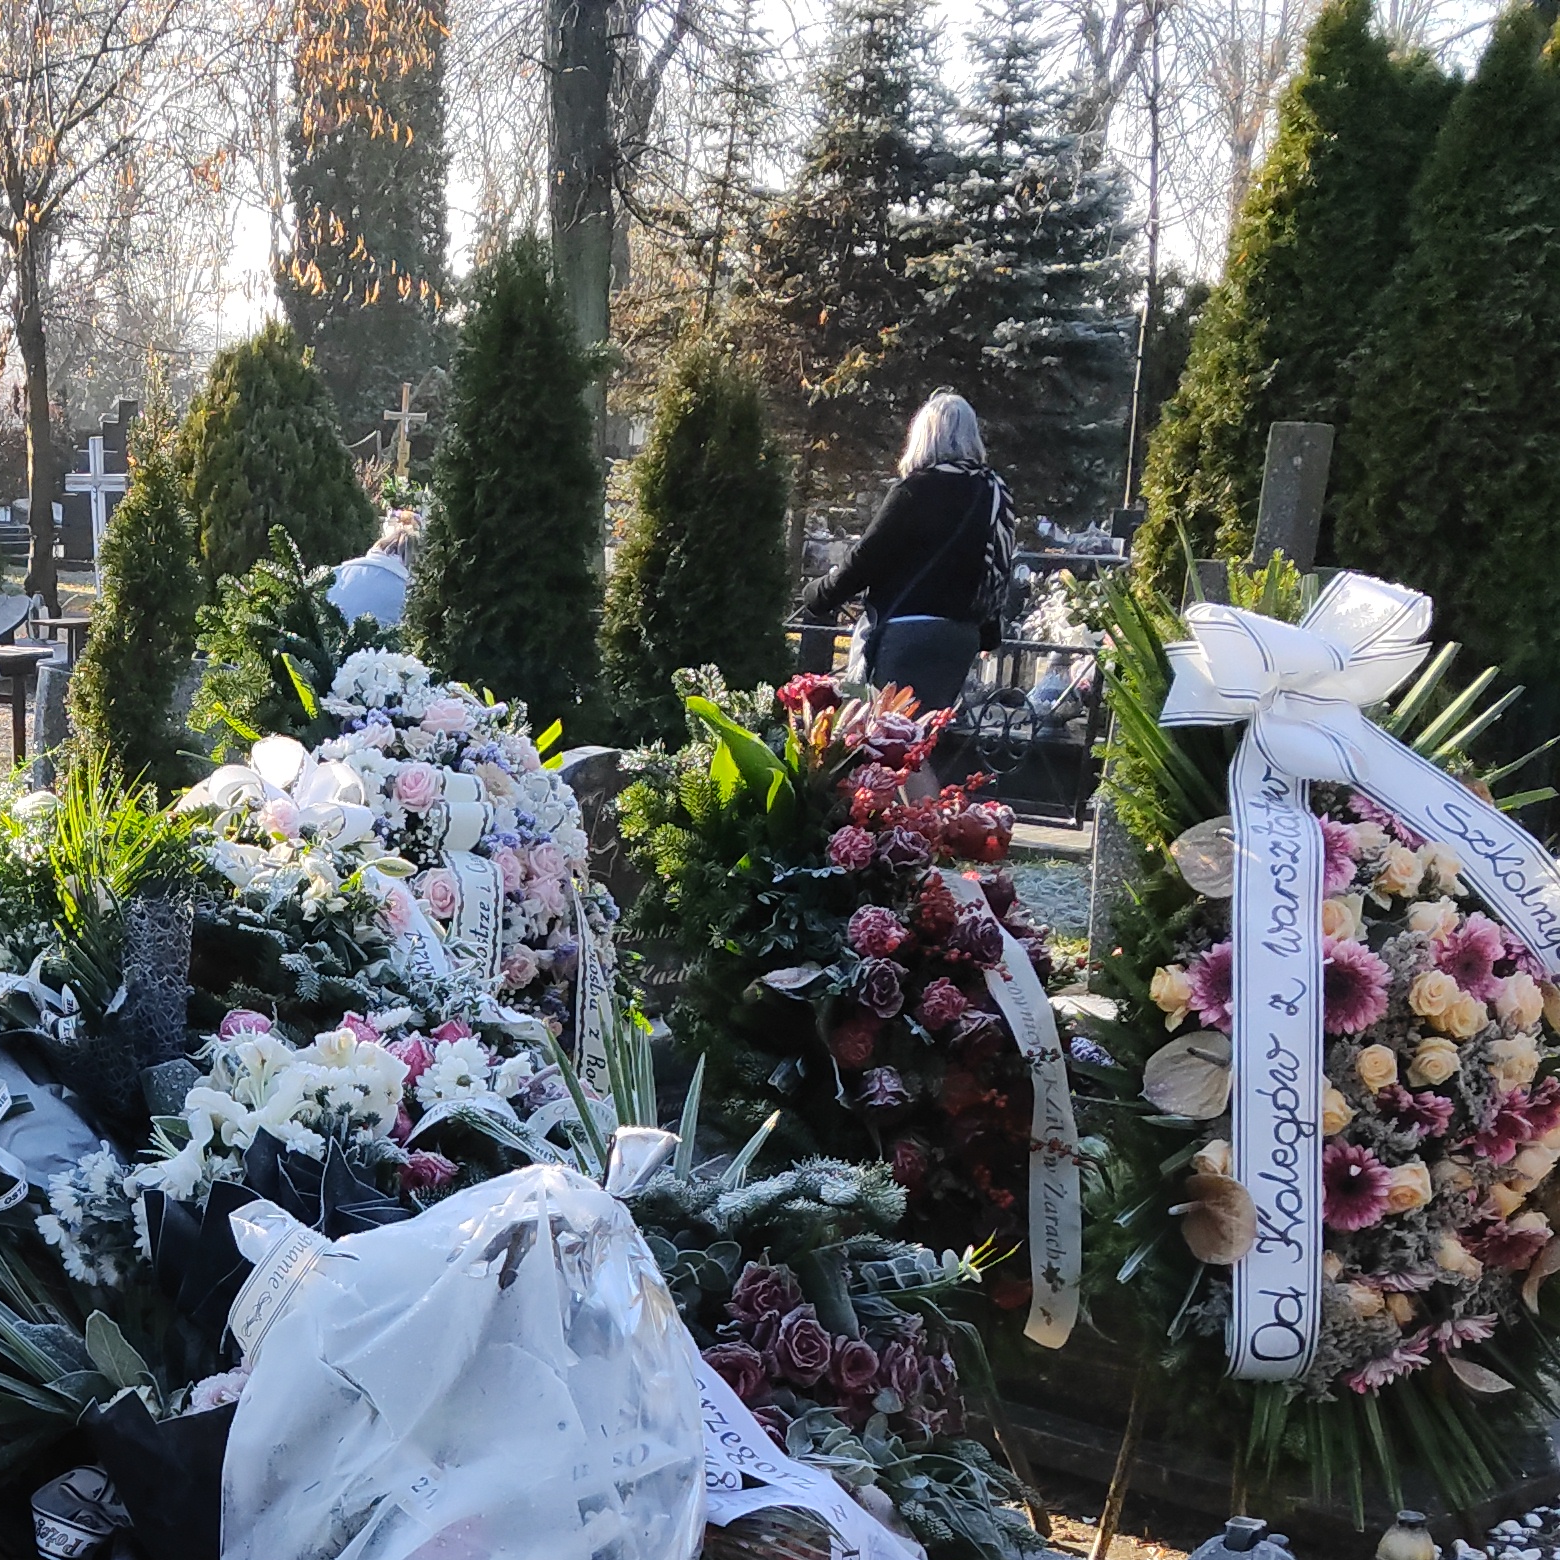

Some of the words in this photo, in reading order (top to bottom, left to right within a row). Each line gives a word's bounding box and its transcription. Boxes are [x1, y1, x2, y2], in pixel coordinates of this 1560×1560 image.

[1270, 977, 1307, 1017] z
[1255, 1031, 1317, 1264] Kolegów
[1250, 1286, 1307, 1363] Od
